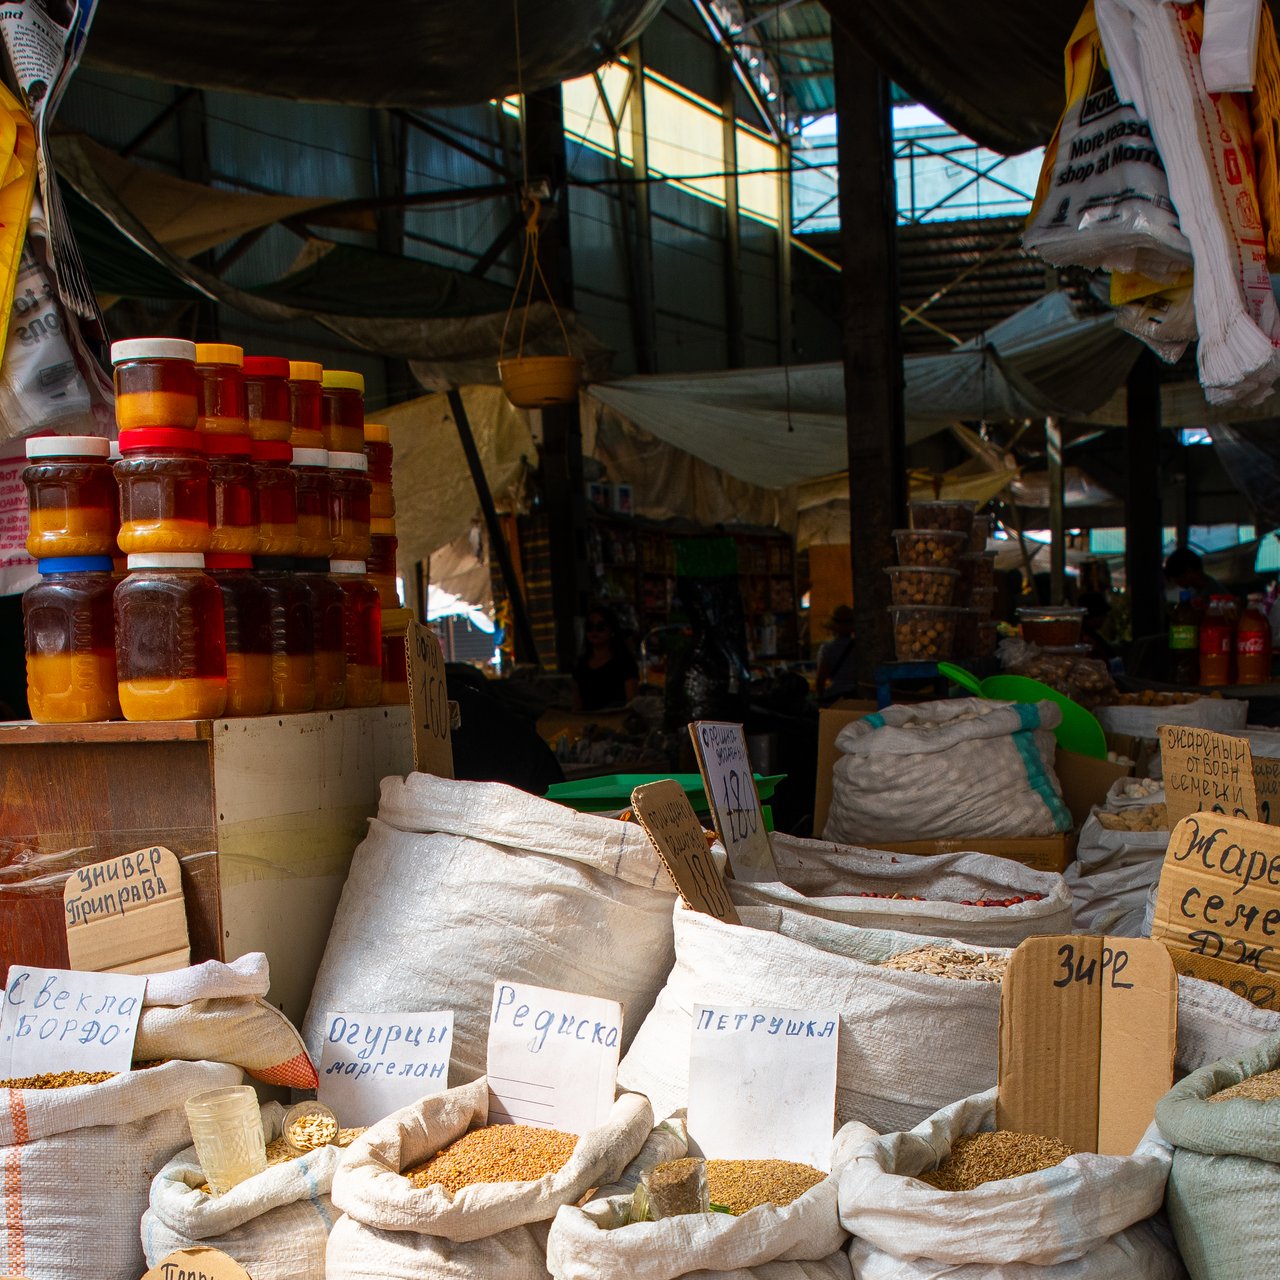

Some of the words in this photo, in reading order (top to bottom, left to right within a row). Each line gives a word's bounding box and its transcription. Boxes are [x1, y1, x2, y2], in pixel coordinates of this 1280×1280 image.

[1071, 131, 1105, 160] More
[1106, 120, 1151, 144] reaso
[1056, 161, 1094, 187] shop
[76, 846, 162, 893] УНИВЕР
[66, 876, 168, 926] ПРИПРАВА
[8, 972, 138, 1018] Свекла
[329, 1016, 448, 1060] Огурцы
[493, 985, 619, 1054] Редиска
[696, 1008, 837, 1040] ПЕТРУШКА
[325, 1058, 445, 1081] маргелан
